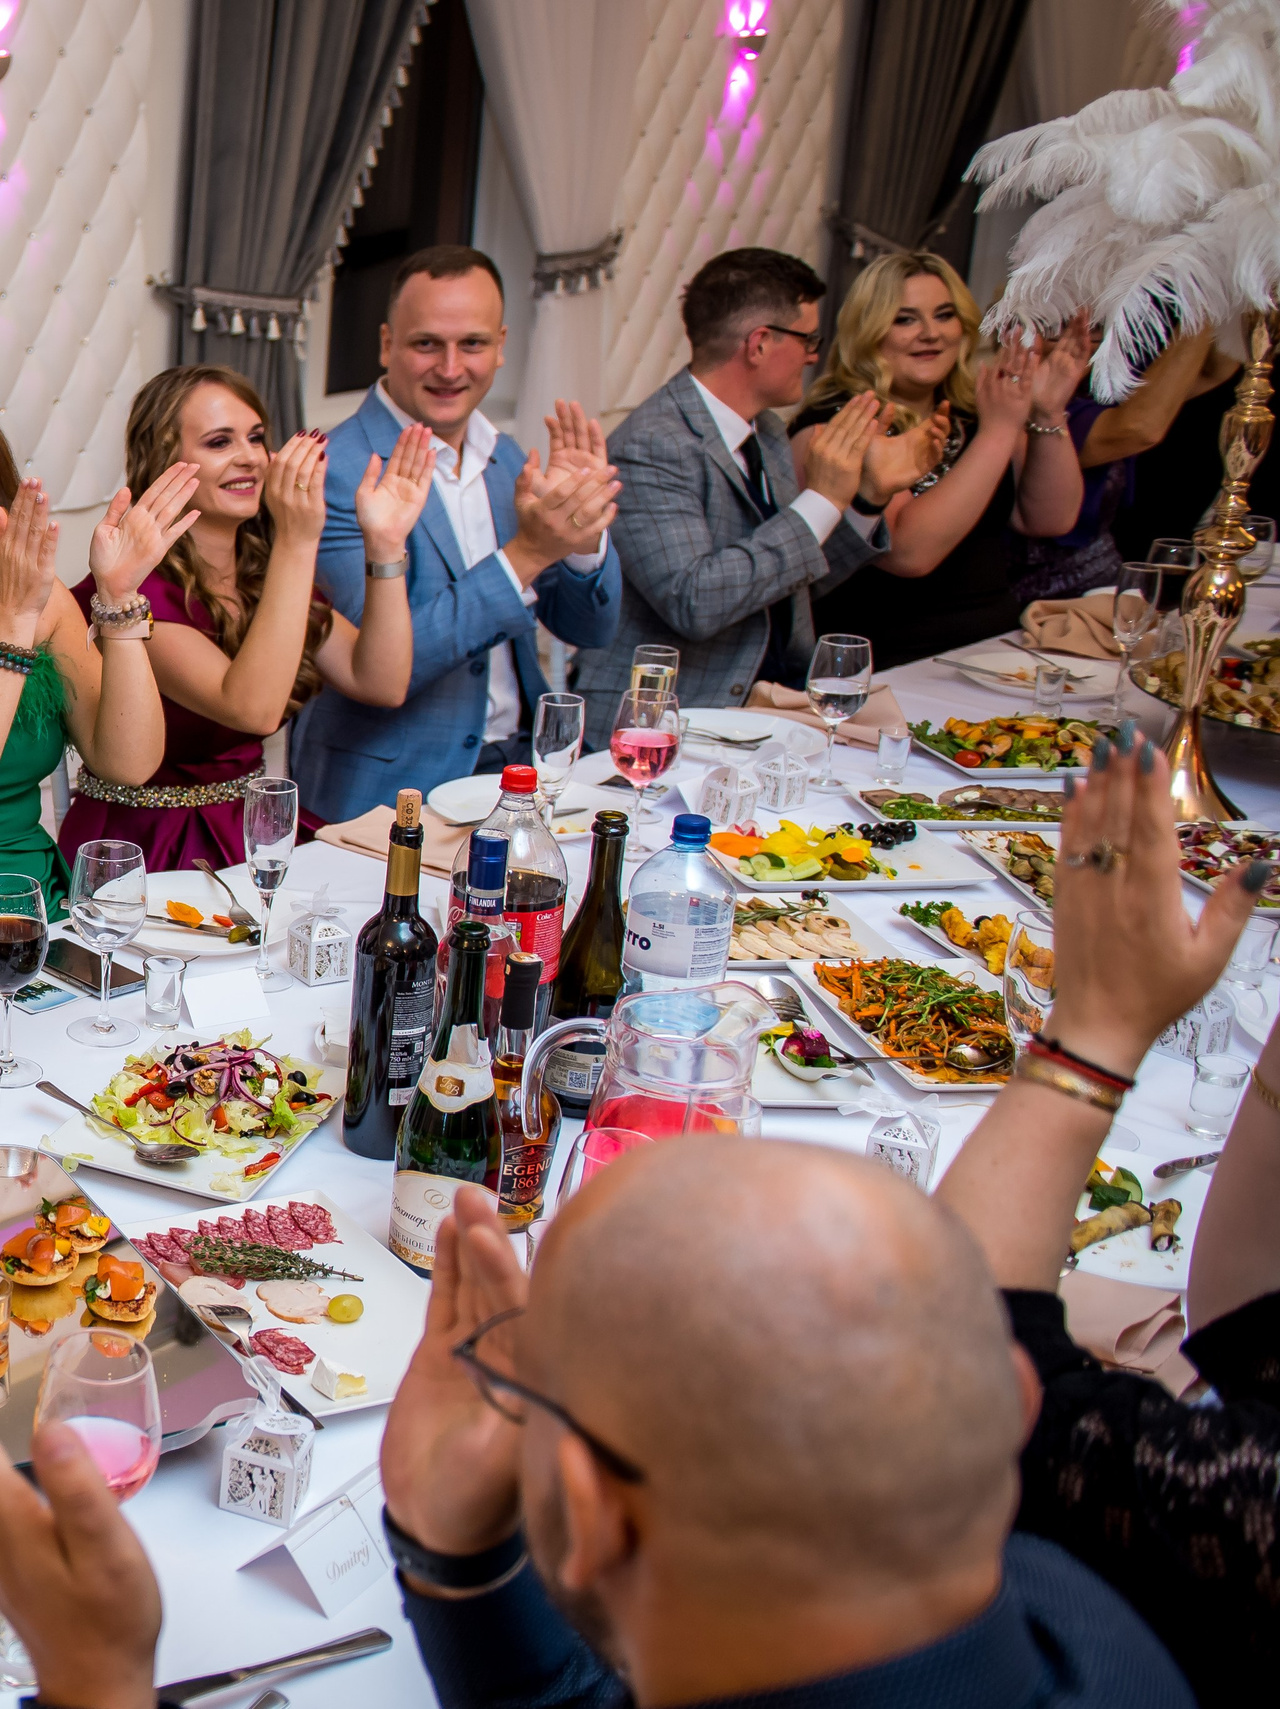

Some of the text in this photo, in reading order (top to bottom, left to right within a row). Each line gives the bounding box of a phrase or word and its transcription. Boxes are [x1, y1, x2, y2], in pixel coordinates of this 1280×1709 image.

[469, 897, 496, 907] FINLANDIA
[626, 928, 651, 950] rro
[503, 1156, 552, 1176] EGEND
[511, 1175, 540, 1189] 1863
